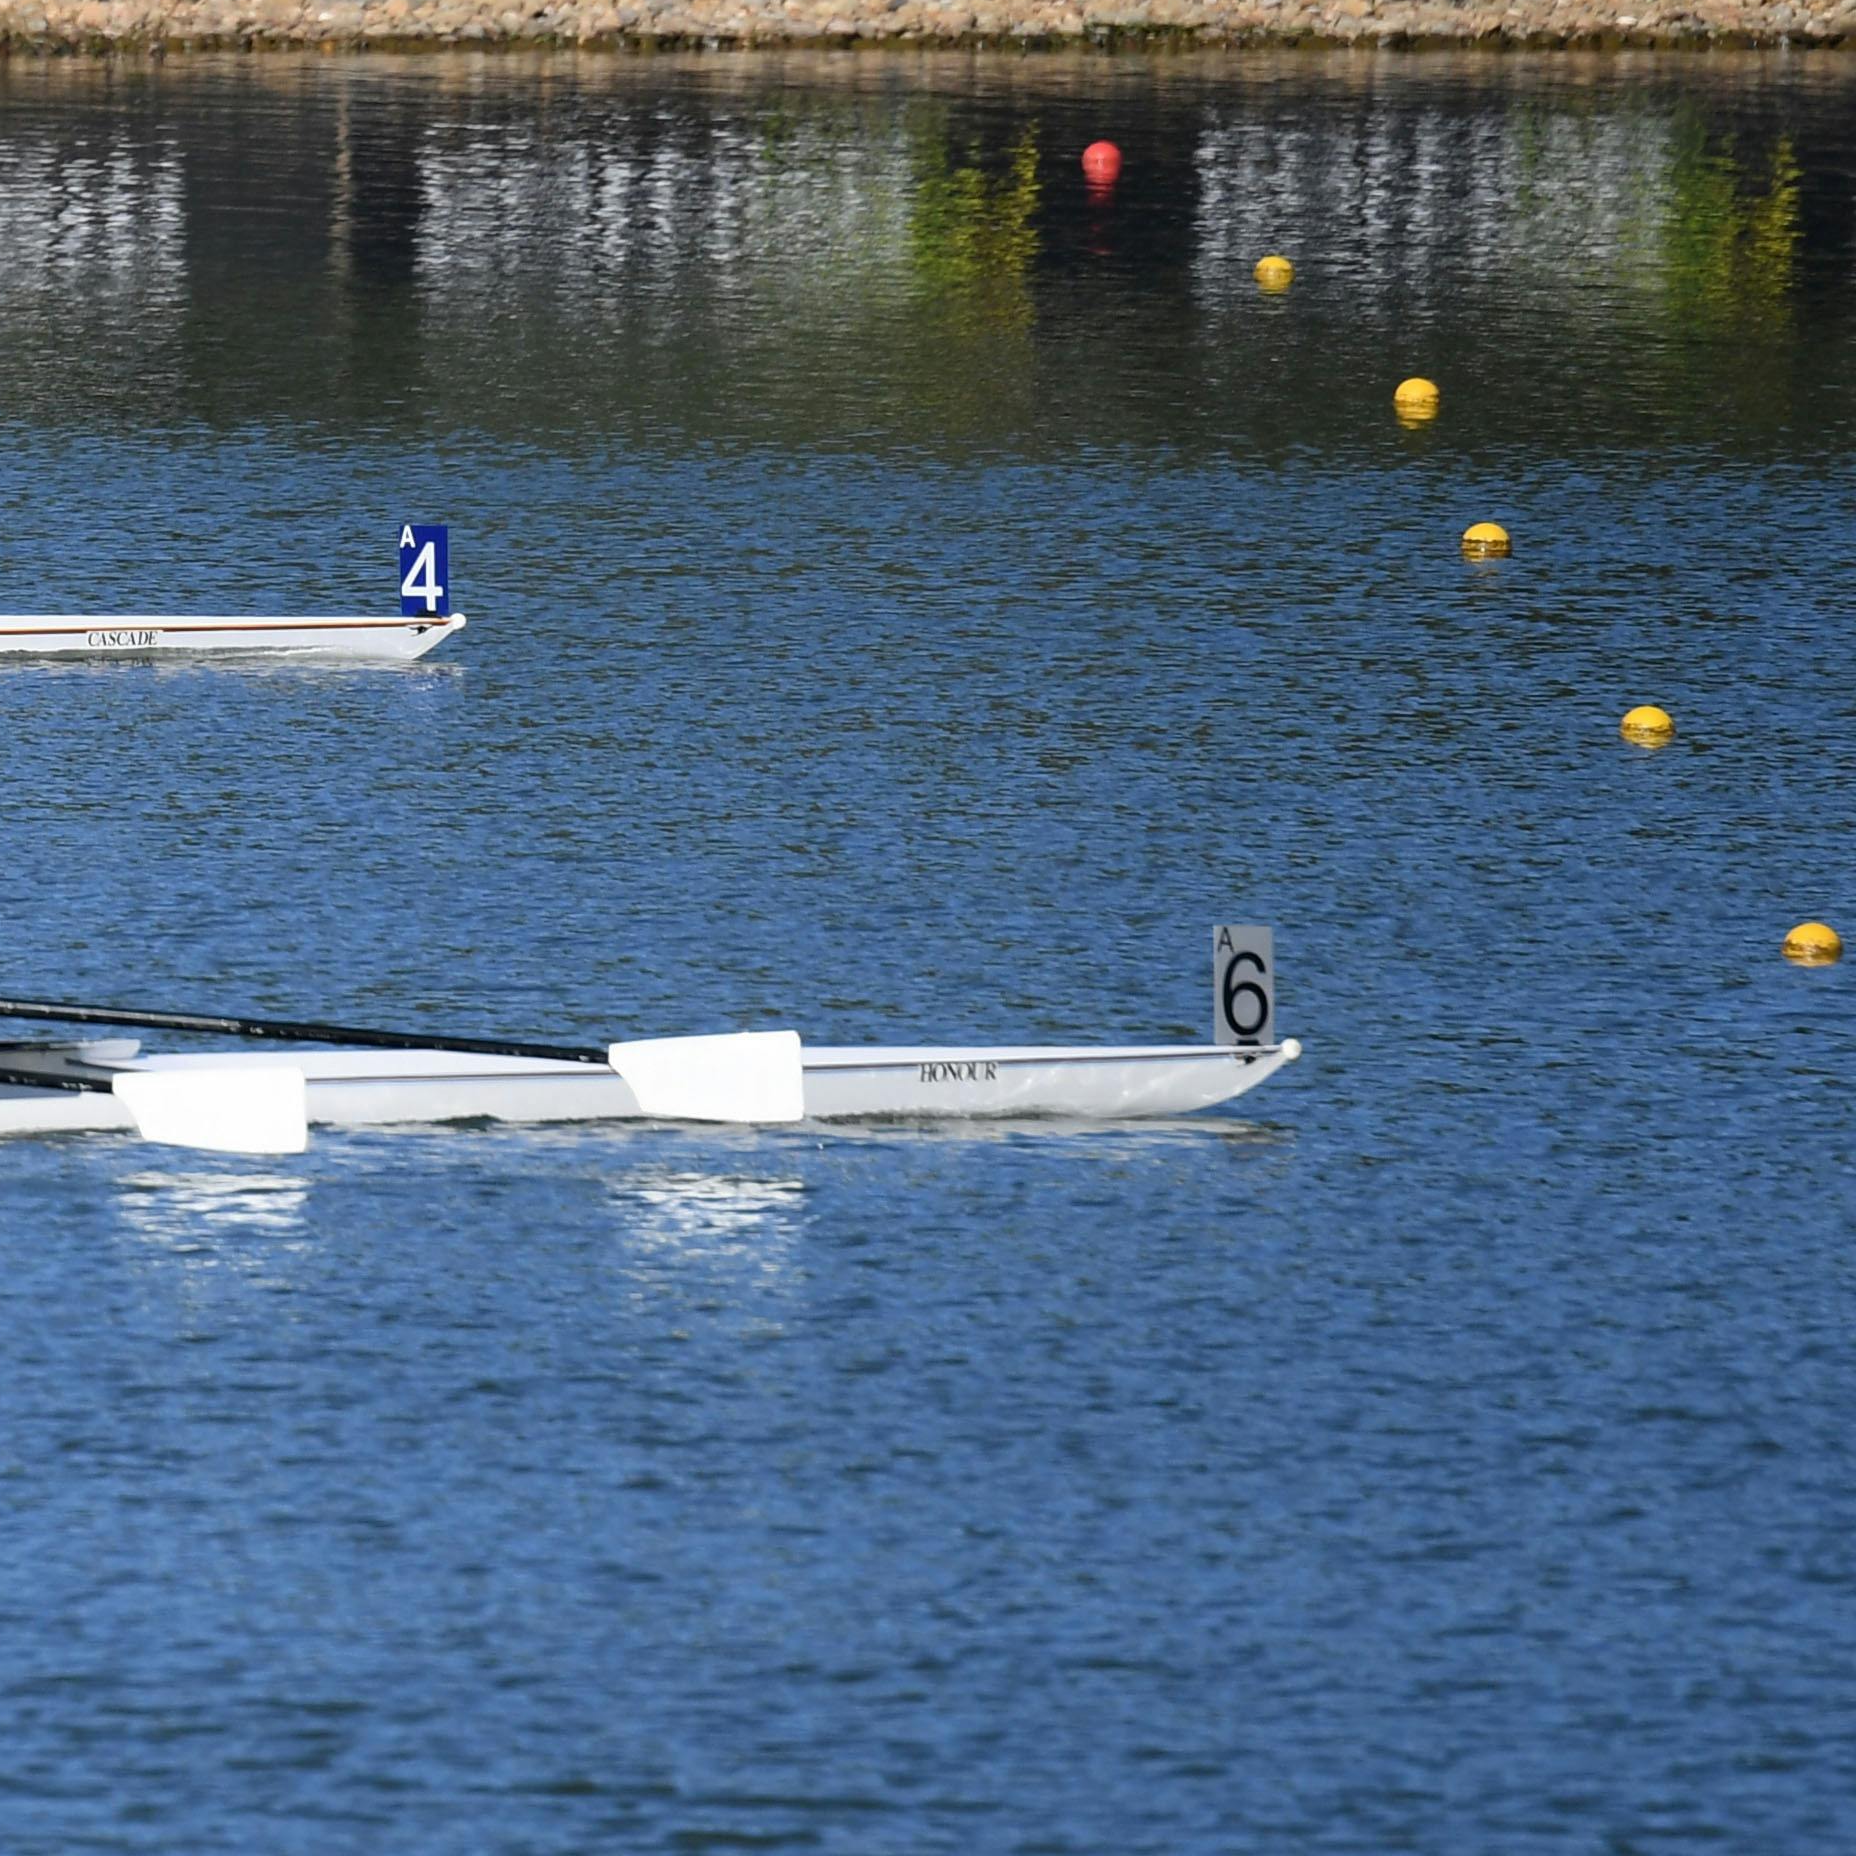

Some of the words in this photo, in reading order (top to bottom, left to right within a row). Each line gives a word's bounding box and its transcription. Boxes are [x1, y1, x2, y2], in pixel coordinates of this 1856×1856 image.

[399, 524, 417, 548] A
[400, 541, 445, 612] 4
[87, 630, 159, 647] CASCADE
[1217, 925, 1235, 953] A
[1221, 950, 1270, 1037] 6
[919, 1061, 997, 1083] HONOUR
